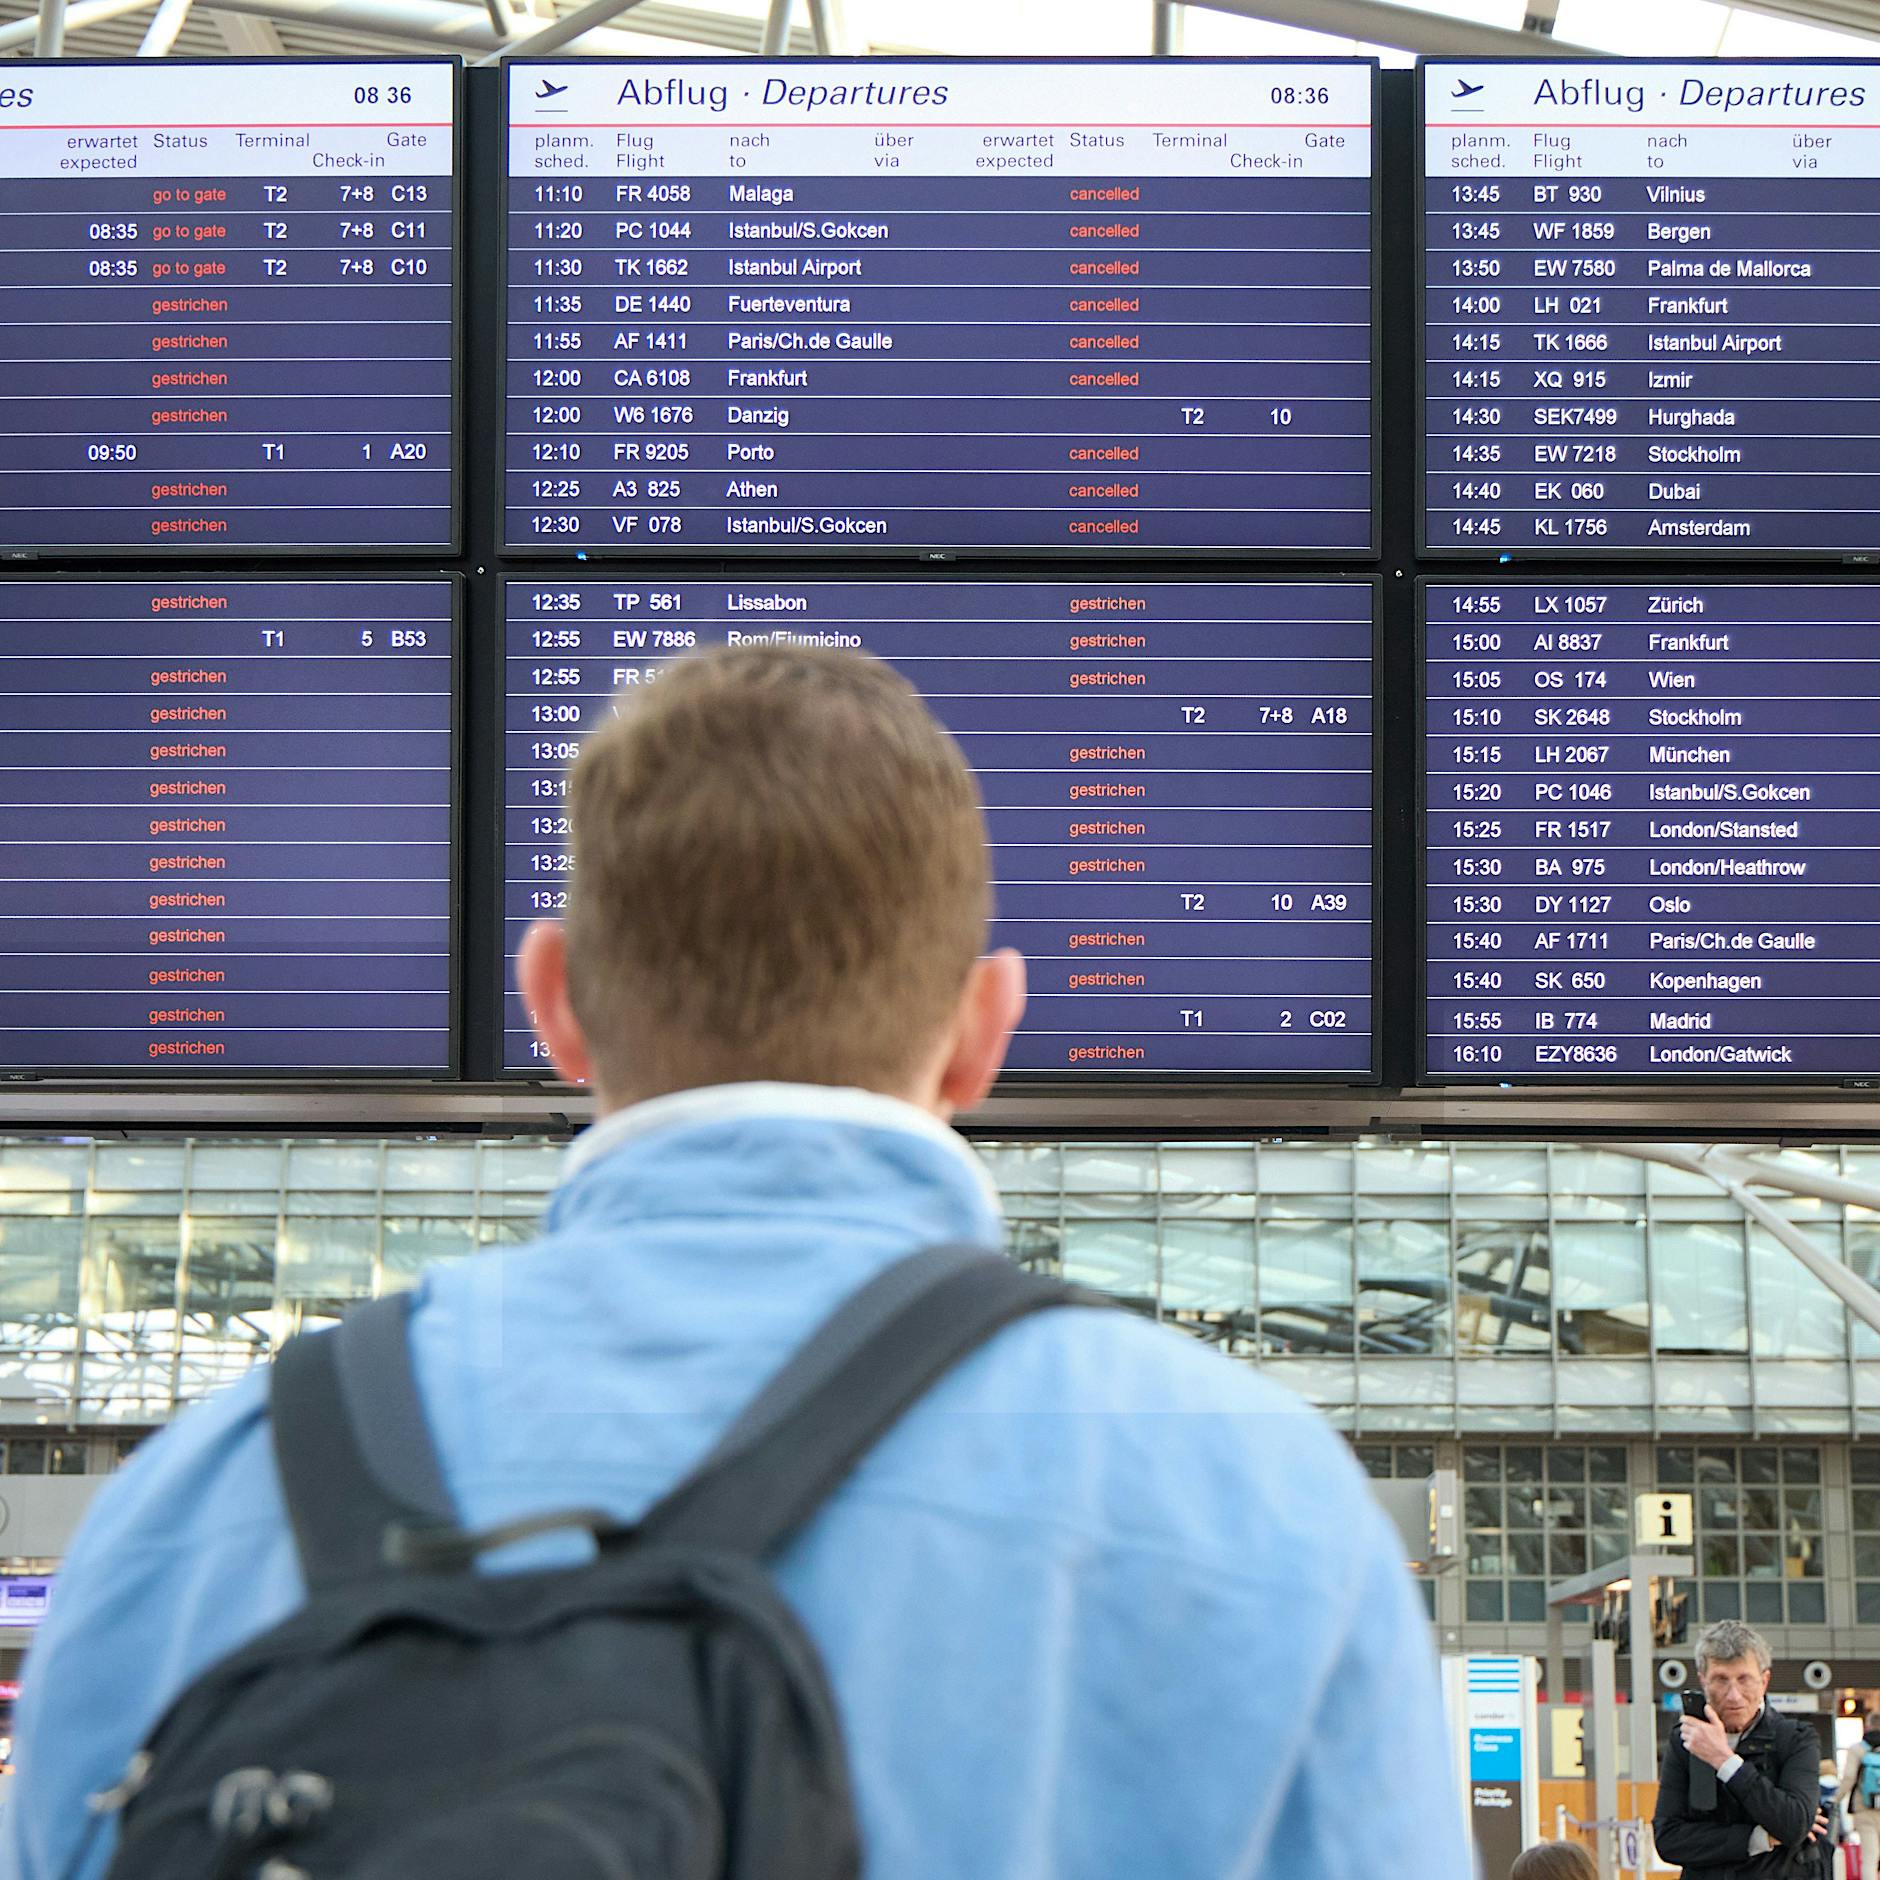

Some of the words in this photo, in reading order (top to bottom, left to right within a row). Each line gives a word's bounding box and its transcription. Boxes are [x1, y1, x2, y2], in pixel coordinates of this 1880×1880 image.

[617, 78, 727, 112] Abflug
[762, 78, 949, 112] Departures
[1271, 87, 1329, 105] 08:36
[1533, 78, 1644, 113] Abflug
[1679, 79, 1866, 113] Departures
[67, 134, 138, 149] erwartet
[153, 133, 208, 148] Status
[235, 133, 310, 148] Terminal
[387, 131, 427, 147] Gate
[535, 133, 595, 151] planm.
[617, 133, 653, 151] Flug
[730, 132, 770, 147] nach
[875, 132, 914, 147] über
[983, 133, 1054, 147] erwartet
[1070, 132, 1125, 147] Status
[1153, 132, 1227, 148] Terminal
[1305, 132, 1345, 148] Gate
[1452, 133, 1511, 151] planm.
[1534, 133, 1571, 151] Flug
[1647, 133, 1687, 148] nach
[1793, 133, 1832, 148] über
[60, 154, 137, 172] expected
[312, 152, 385, 168] Check-in
[535, 153, 590, 168] sched.
[617, 153, 665, 171] Flight
[729, 155, 746, 168] to
[874, 153, 899, 168] via
[976, 153, 1053, 170] expected
[1230, 153, 1303, 168] Check-in
[1451, 153, 1506, 168] sched.
[1534, 153, 1582, 171] Flight
[1647, 155, 1664, 169] to
[1792, 154, 1817, 169] via
[152, 190, 172, 205] go
[175, 188, 191, 201] to
[194, 188, 227, 205] gate
[263, 185, 288, 202] T2
[340, 185, 374, 202] 7+8
[391, 184, 428, 202] C13
[535, 185, 583, 202] 11:10
[616, 185, 642, 202] FR
[646, 184, 691, 202] 4058
[729, 184, 794, 206] Malaga
[1069, 186, 1140, 201] cancelled
[1452, 185, 1501, 203] 13:45
[1534, 185, 1559, 203] BT
[1568, 185, 1602, 203] 930
[1646, 185, 1706, 203] Vilnius
[89, 223, 138, 240] 08:35
[152, 226, 171, 241] go
[175, 224, 190, 238] to
[193, 224, 227, 241] gate
[263, 222, 288, 239] T2
[340, 222, 374, 239] 7+8
[391, 221, 425, 239] C11
[534, 258, 582, 276] 11:30
[614, 258, 641, 276] TK
[646, 258, 689, 276] 1662
[729, 258, 798, 276] Istanbul
[801, 258, 862, 280] Airport
[1069, 260, 1140, 275] cancelled
[1452, 259, 1501, 277] 13:50
[1534, 259, 1568, 277] EW
[1571, 259, 1616, 277] 7580
[1648, 259, 1705, 277] Palma
[1709, 259, 1732, 277] de
[1736, 259, 1812, 277] Mallorca
[151, 298, 228, 315] gestrichen
[533, 406, 581, 424] 12:00
[613, 406, 645, 423] W6
[651, 406, 694, 424] 1676
[728, 406, 789, 428] Danzig
[1180, 407, 1204, 425] T2
[1270, 407, 1292, 425] 10
[1452, 407, 1501, 425] 14:30
[1533, 407, 1618, 425] SEK7499
[1648, 408, 1736, 430] Hurghada
[88, 444, 137, 461] 09:50
[262, 443, 284, 460] T1
[362, 443, 371, 460] 1
[390, 443, 427, 460] A20
[531, 516, 580, 533] 12:30
[611, 516, 639, 533] VF
[648, 516, 682, 533] 078
[727, 516, 887, 534] Istanbul/S.Gokcen
[1068, 519, 1139, 534] cancelled
[1452, 518, 1501, 535] 14:45
[1535, 518, 1560, 536] KL
[1564, 518, 1608, 536] 1756
[1647, 518, 1751, 536] Amsterdam
[151, 594, 228, 612] gestrichen
[532, 593, 581, 611] 12:35
[613, 593, 641, 611] TP
[649, 593, 681, 611] 561
[727, 593, 807, 611] Lissabon
[1069, 596, 1146, 614] gestrichen
[1452, 596, 1501, 614] 14:55
[1534, 596, 1560, 614] LX
[1564, 596, 1608, 614] 1057
[1647, 596, 1704, 614] Zürich
[261, 630, 284, 647] T1
[361, 630, 373, 647] 5
[391, 630, 427, 647] B53
[532, 630, 581, 648] 12:55
[613, 630, 648, 648] EW
[652, 630, 696, 648] 7886
[727, 630, 863, 648] Rom/Fiumicino
[1069, 633, 1146, 651] gestrichen
[532, 668, 581, 685] 12:55
[613, 668, 640, 685] FR
[1069, 671, 1146, 689] gestrichen
[531, 705, 581, 722] 13:00
[1180, 706, 1206, 724] T2
[1259, 706, 1294, 724] 7+8
[1310, 706, 1348, 724] A18
[531, 742, 580, 760] 13:05
[1069, 745, 1146, 763] gestrichen
[1453, 745, 1502, 763] 15:15
[1535, 746, 1560, 763] LH
[1564, 745, 1610, 763] 2067
[1649, 745, 1731, 763] München
[149, 817, 226, 835] gestrichen
[530, 854, 577, 872] 13:25
[1069, 858, 1145, 875] gestrichen
[1453, 858, 1502, 876] 15:30
[1535, 858, 1563, 876] BA
[1571, 858, 1606, 876] 975
[1649, 858, 1807, 876] London/Heathrow
[530, 891, 573, 909] 13:2
[1180, 893, 1205, 911] T2
[1271, 893, 1293, 911] 10
[1310, 894, 1347, 911] A39
[1179, 1010, 1203, 1027] T1
[1280, 1010, 1292, 1028] 2
[1309, 1010, 1346, 1028] C02
[148, 1040, 225, 1058] gestrichen
[1453, 1045, 1502, 1063] 16:10
[1535, 1045, 1618, 1063] EZY8636
[1650, 1045, 1793, 1063] London/Gatwick
[1659, 1500, 1677, 1537] i
